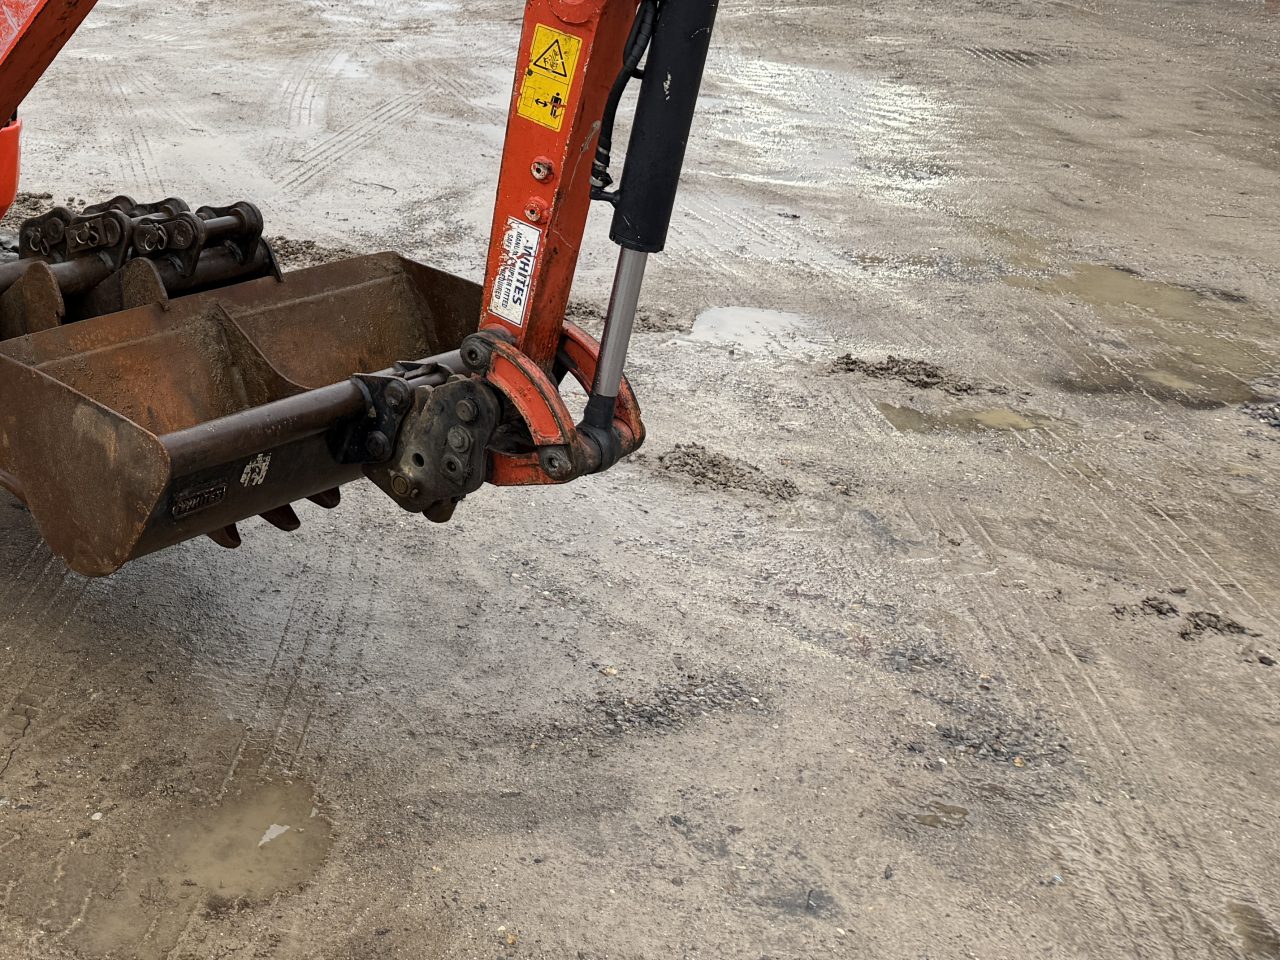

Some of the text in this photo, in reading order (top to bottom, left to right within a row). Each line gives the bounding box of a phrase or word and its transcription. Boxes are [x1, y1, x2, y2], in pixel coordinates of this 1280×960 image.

[512, 231, 523, 257] MANUA
[512, 245, 533, 307] WHITES
[502, 287, 512, 309] FITTED
